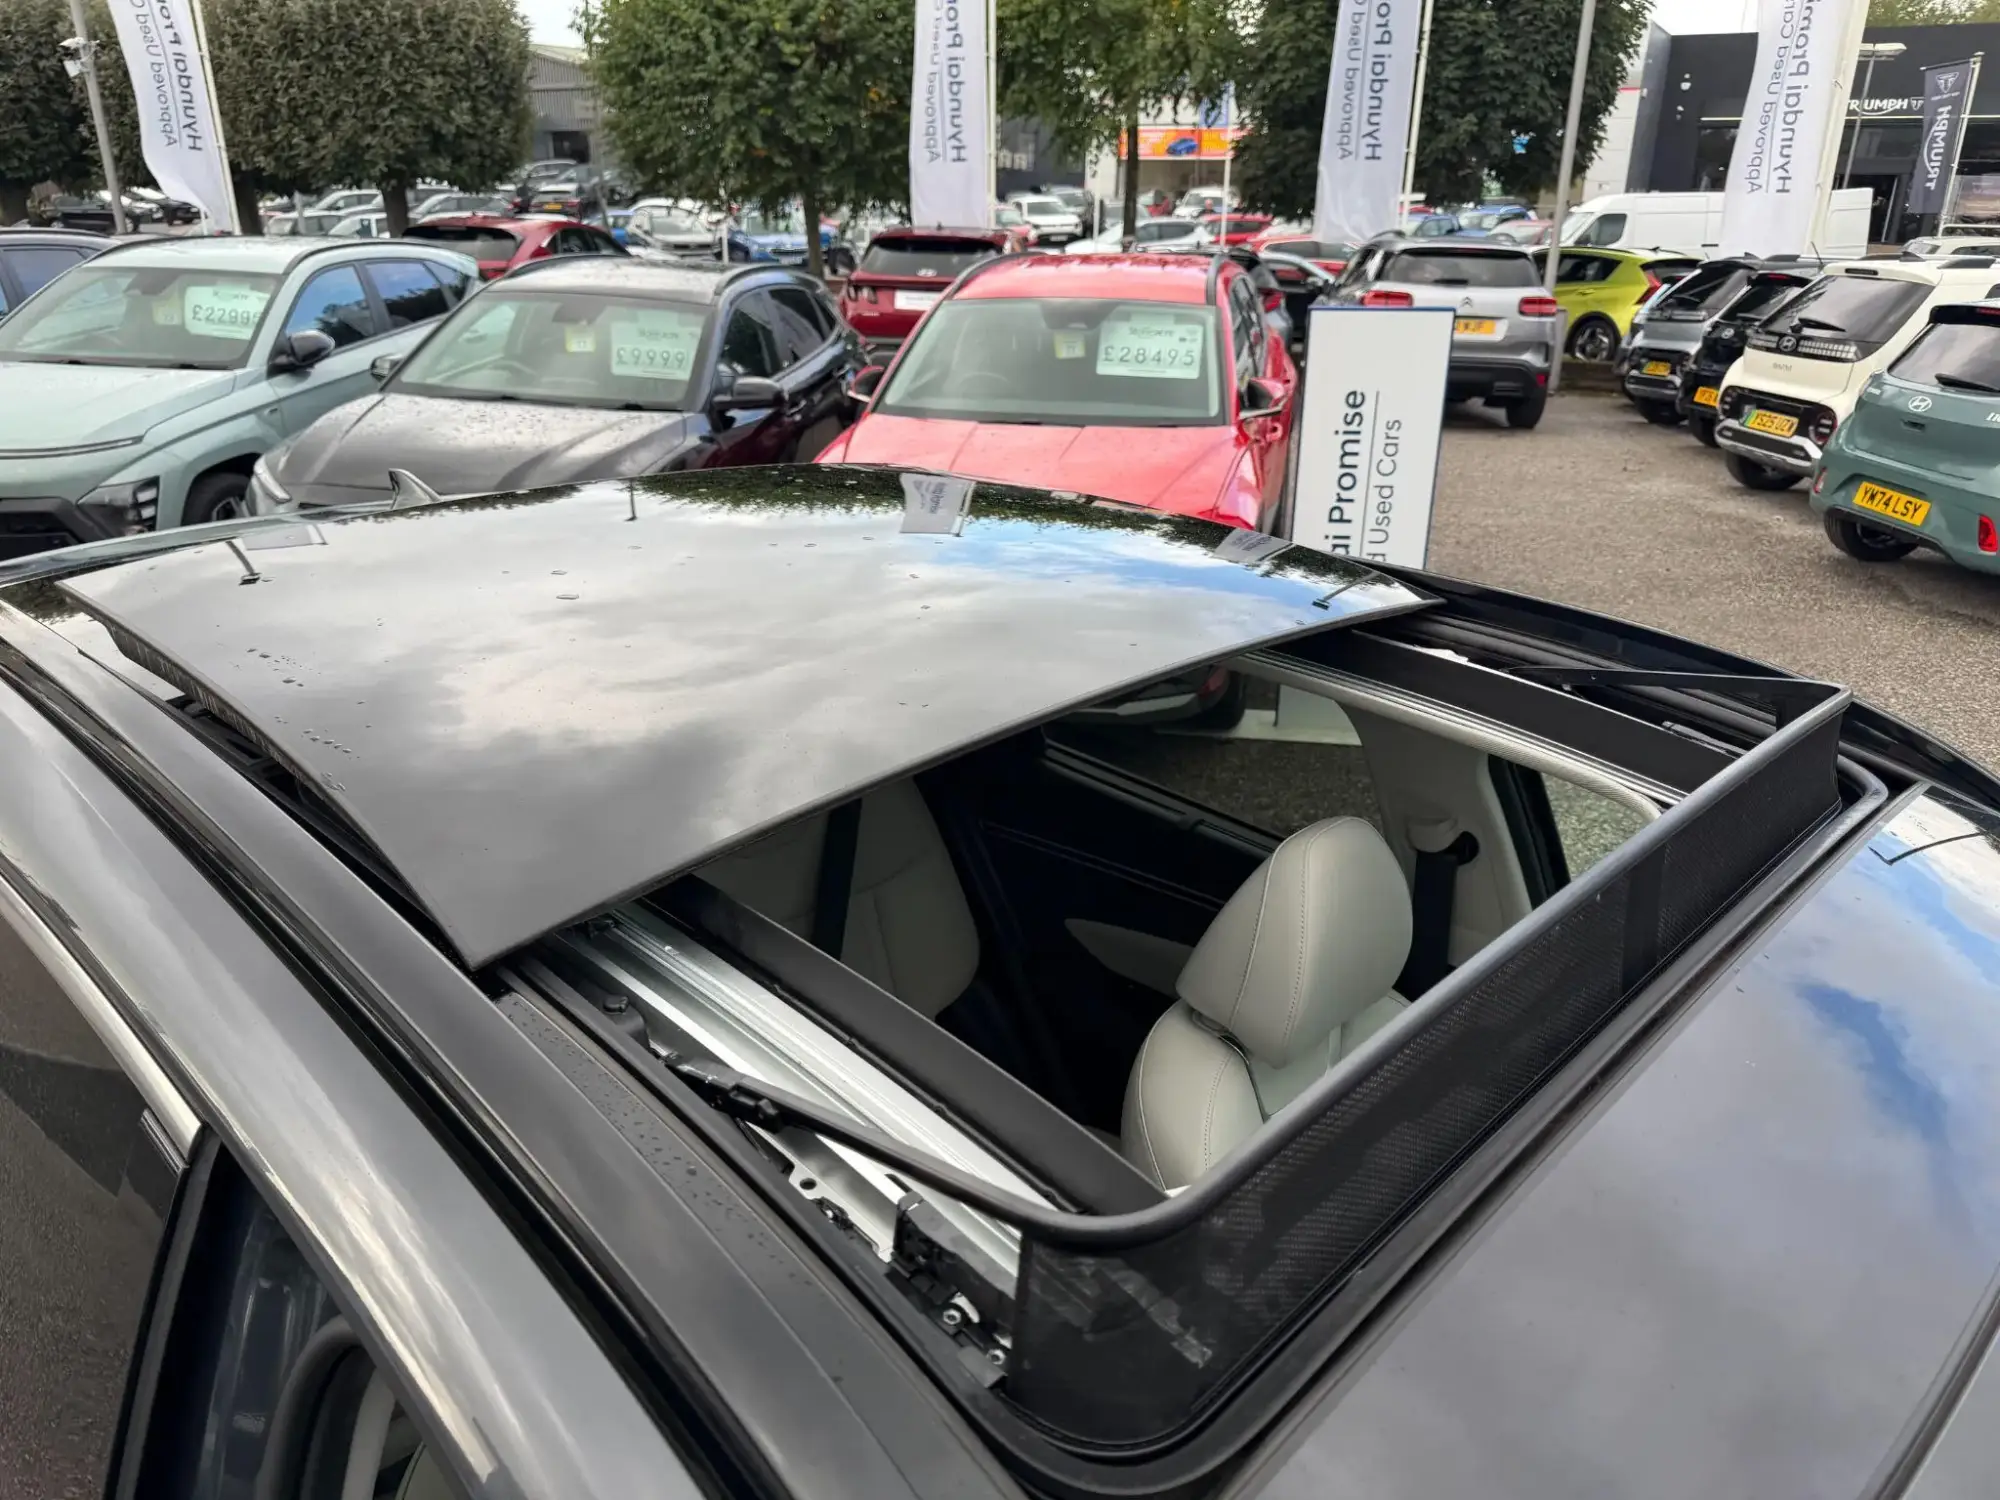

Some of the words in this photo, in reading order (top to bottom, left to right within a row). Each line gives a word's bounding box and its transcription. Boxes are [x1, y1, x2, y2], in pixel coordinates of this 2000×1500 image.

[1103, 345, 1195, 367] £28495
[1328, 390, 1366, 524] Promise
[1376, 419, 1402, 477] Cars
[1368, 485, 1395, 545] Used
[1891, 494, 1923, 520] LSY
